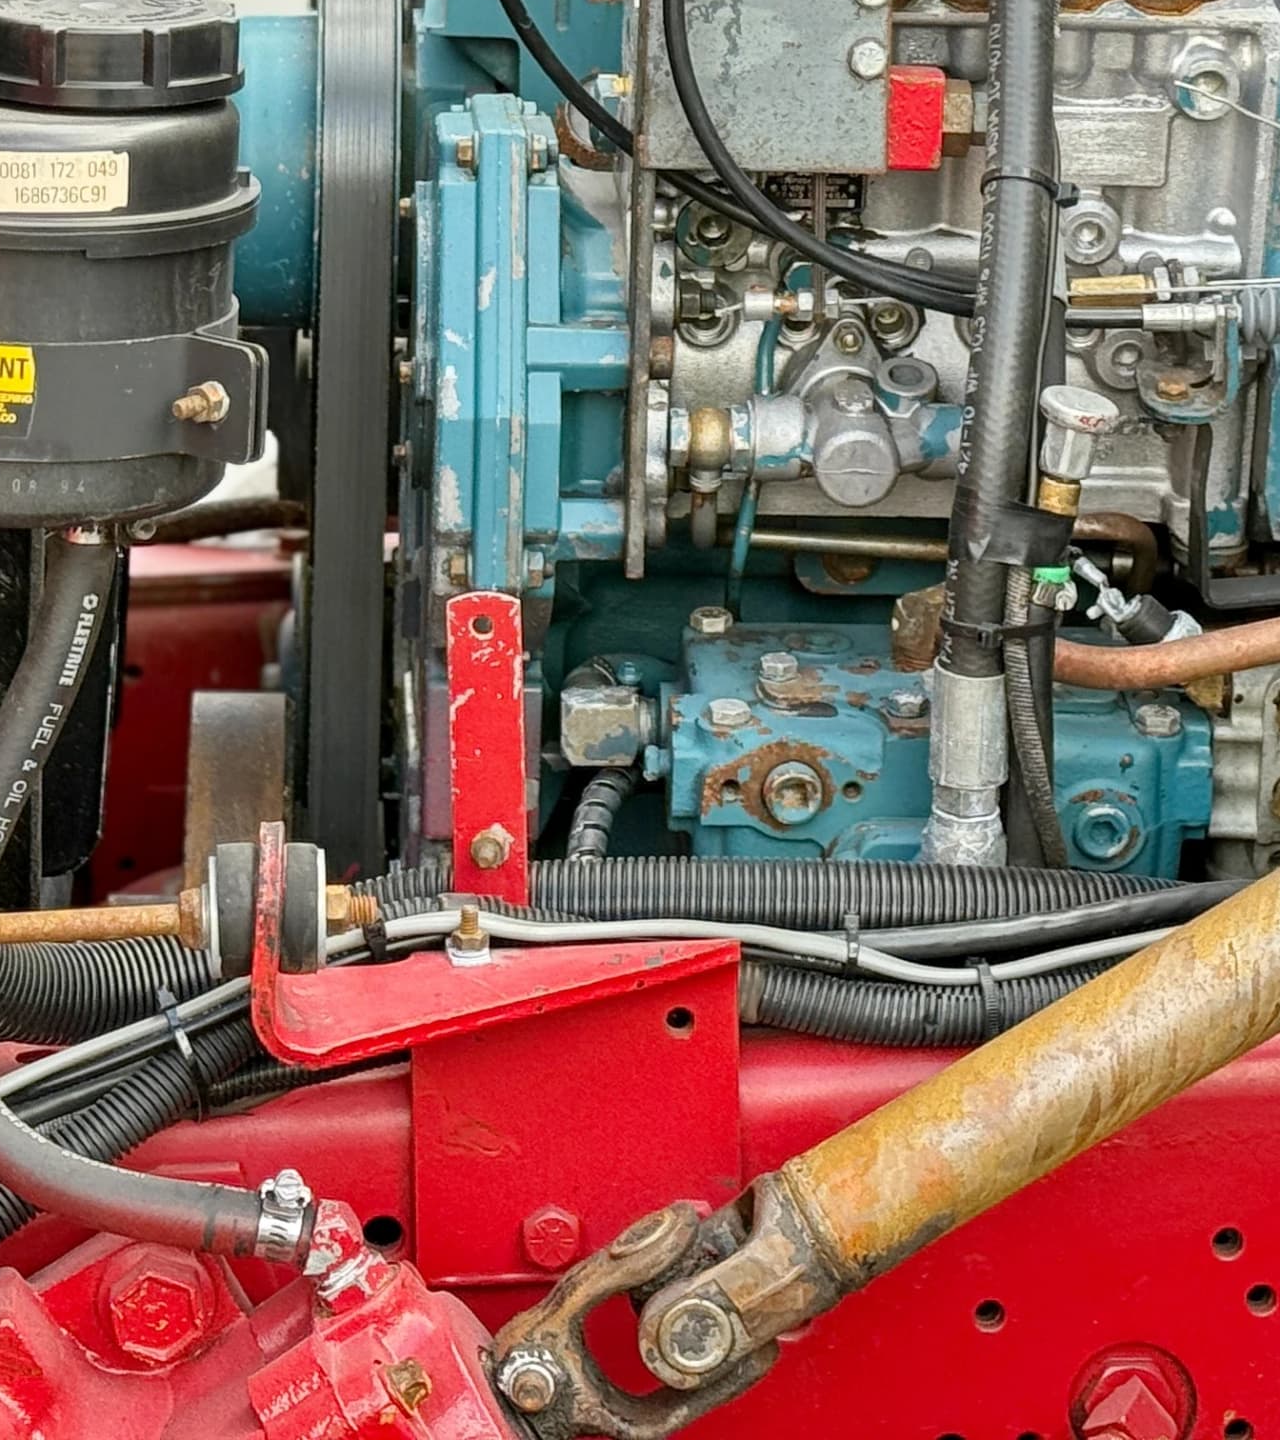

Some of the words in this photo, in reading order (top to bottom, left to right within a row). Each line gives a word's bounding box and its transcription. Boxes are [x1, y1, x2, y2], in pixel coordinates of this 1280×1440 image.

[0, 161, 36, 179] 0081
[50, 161, 75, 179] 172
[15, 186, 106, 204] 1686736C91
[59, 612, 94, 688] FLEETRITE
[31, 702, 64, 750] FUEL
[22, 759, 38, 772] &
[4, 779, 28, 809] OIL
